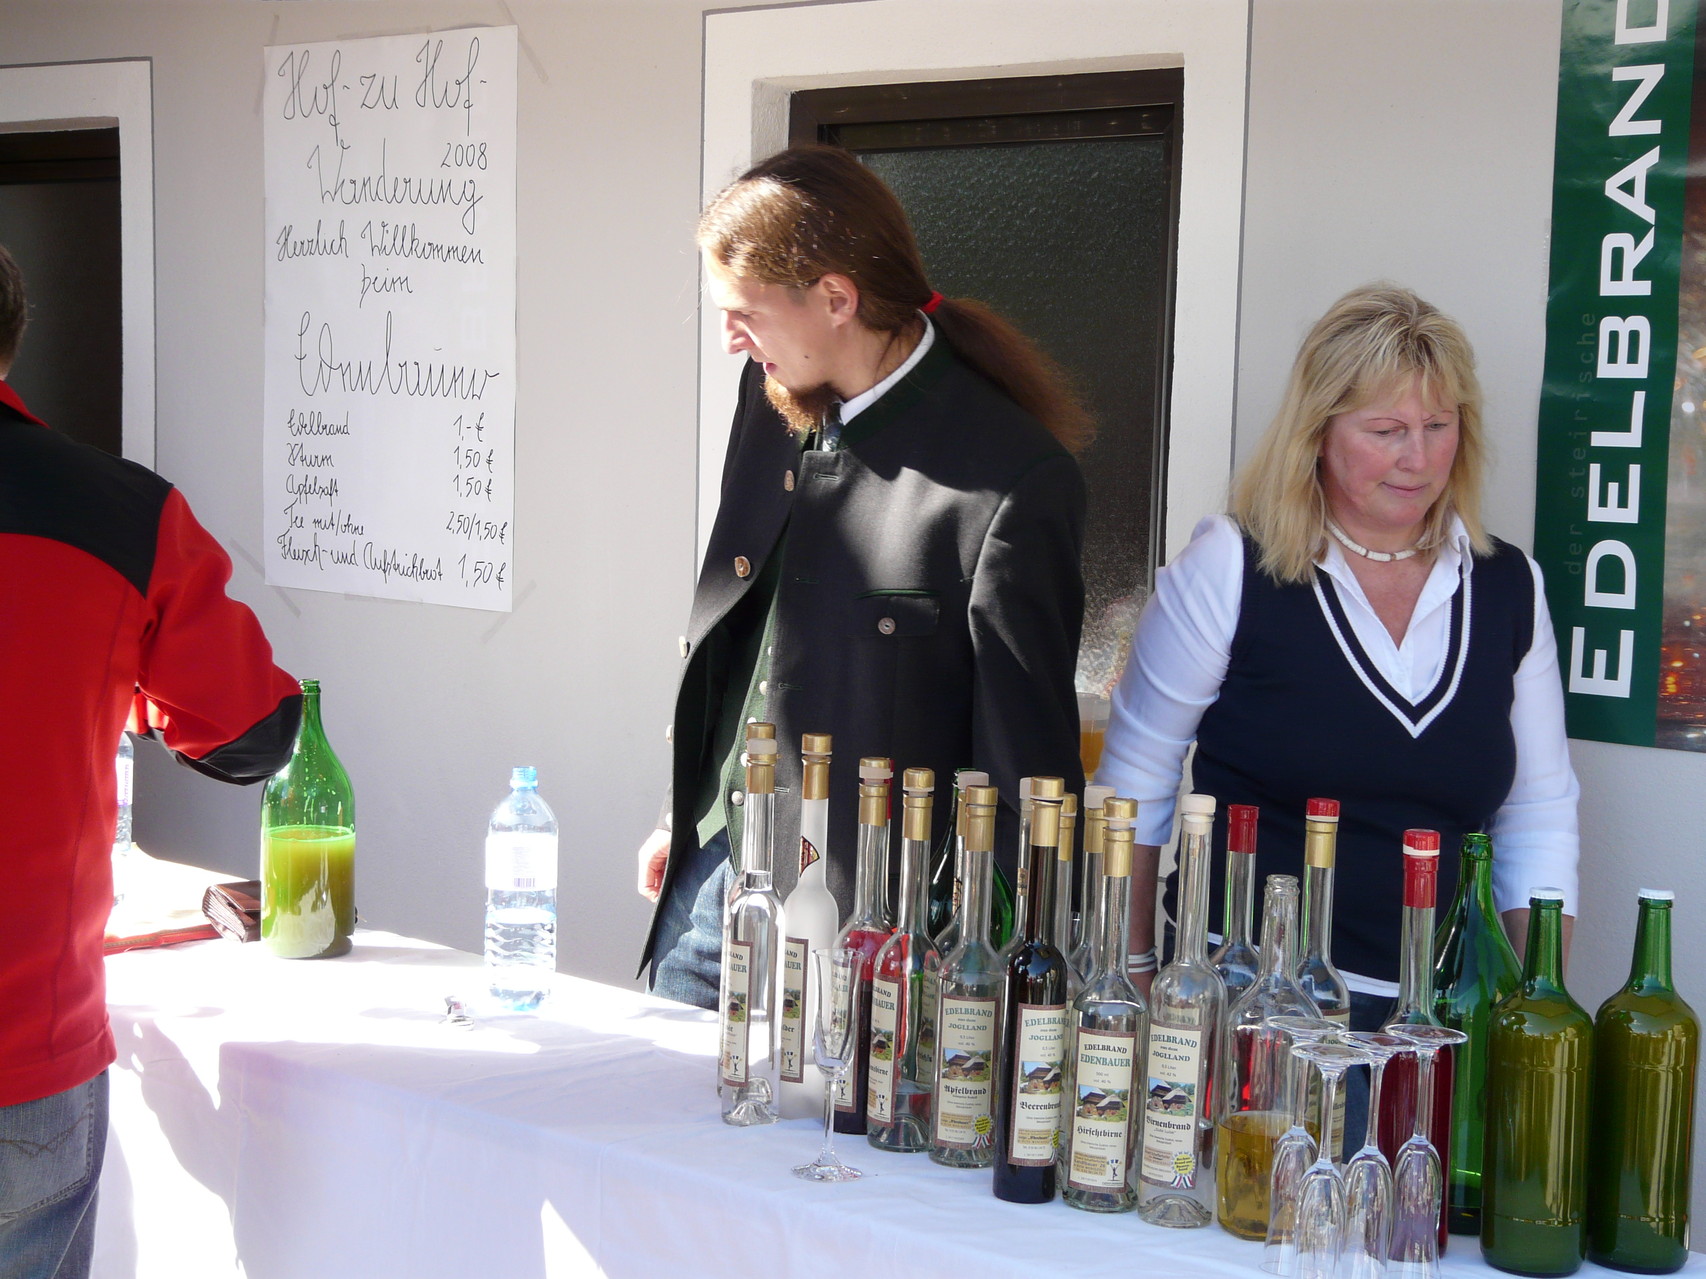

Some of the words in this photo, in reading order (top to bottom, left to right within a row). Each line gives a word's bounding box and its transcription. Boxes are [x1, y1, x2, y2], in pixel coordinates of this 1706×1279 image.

[360, 73, 399, 110] zu
[441, 142, 487, 170] 2008
[307, 138, 483, 235] Wanderung
[276, 219, 348, 262] Herzlich
[360, 220, 484, 264] Willkommen
[360, 264, 413, 308] beim
[1568, 0, 1669, 698] EDELBRAND
[286, 442, 335, 468] Sturm
[286, 474, 339, 507] Apfelsaft
[944, 1007, 993, 1018] EDELBRAND
[1083, 1043, 1128, 1054] EDELBRAND
[1150, 1033, 1198, 1049] EDELBRAND
[1080, 1053, 1131, 1068] EDENBAUER
